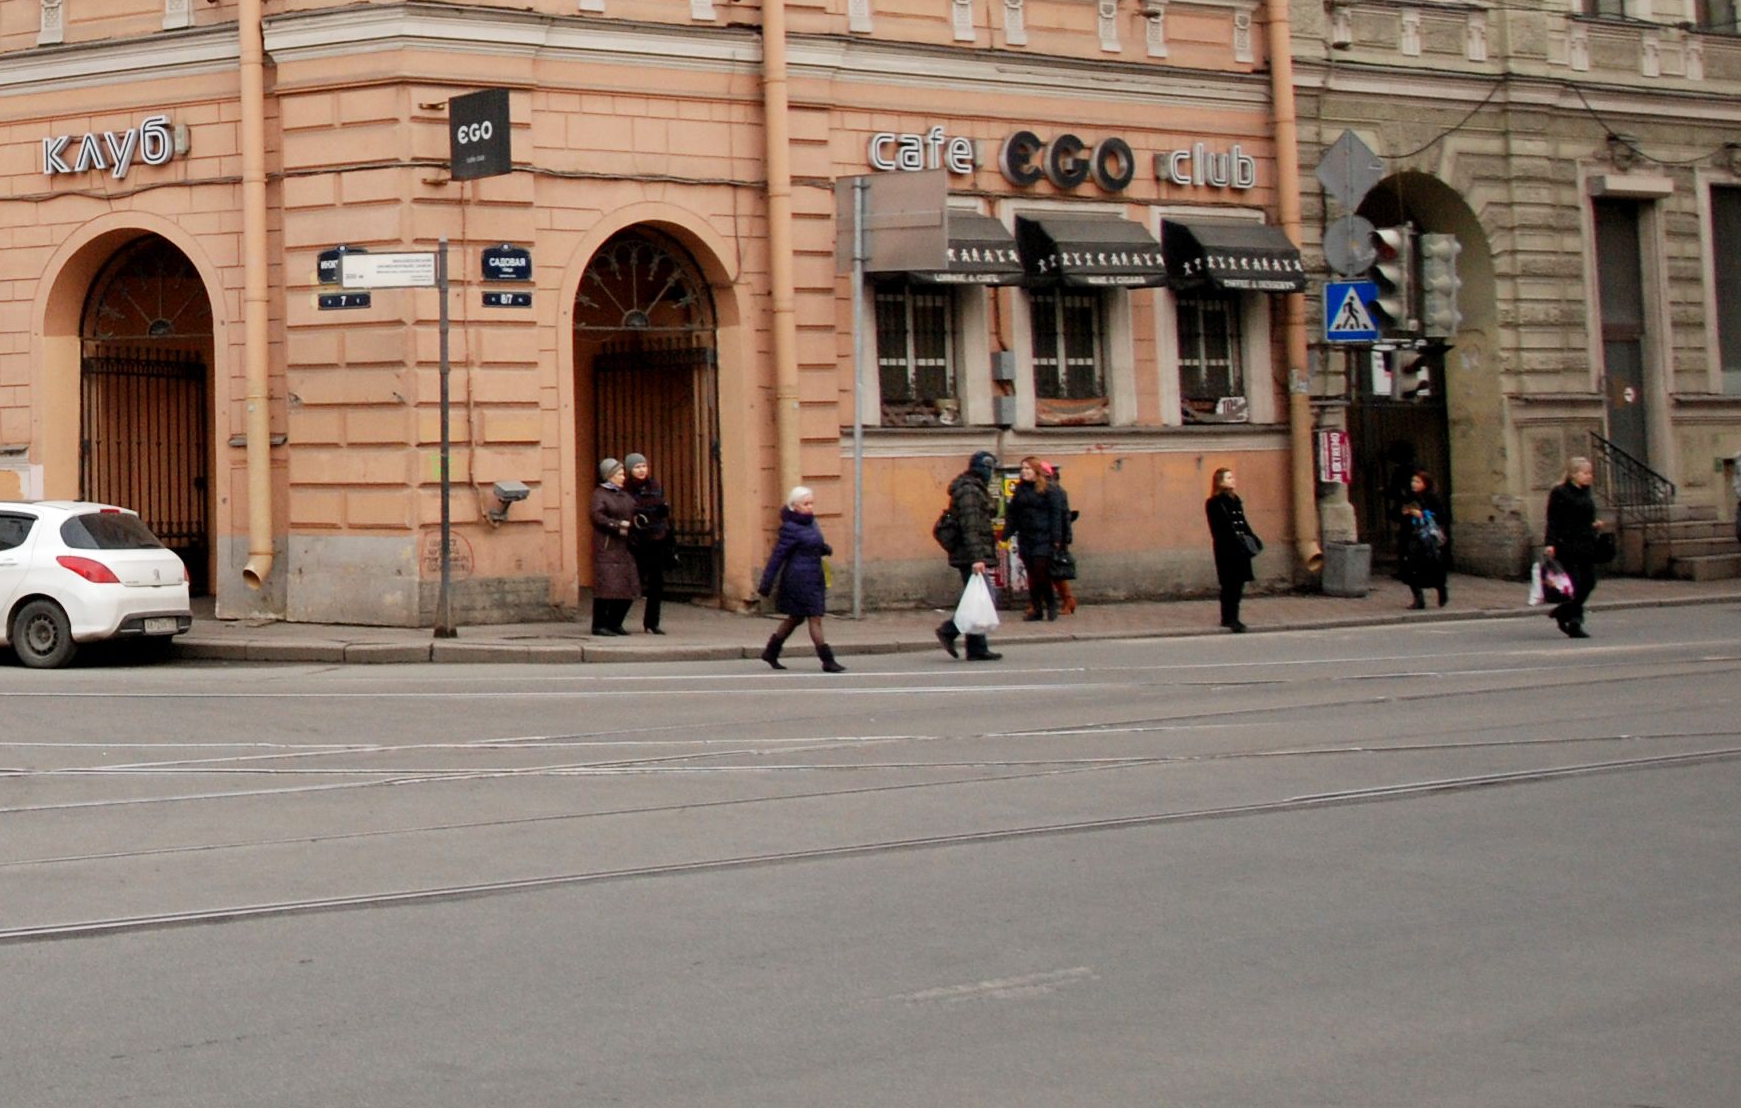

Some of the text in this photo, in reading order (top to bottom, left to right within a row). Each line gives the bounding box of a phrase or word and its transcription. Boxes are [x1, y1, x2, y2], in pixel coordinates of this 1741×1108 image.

[457, 120, 493, 144] EGO
[43, 115, 175, 180] клуб
[868, 125, 1256, 192] cafe EGO club
[489, 257, 526, 267] САДОВАЯ
[340, 295, 347, 306] 7
